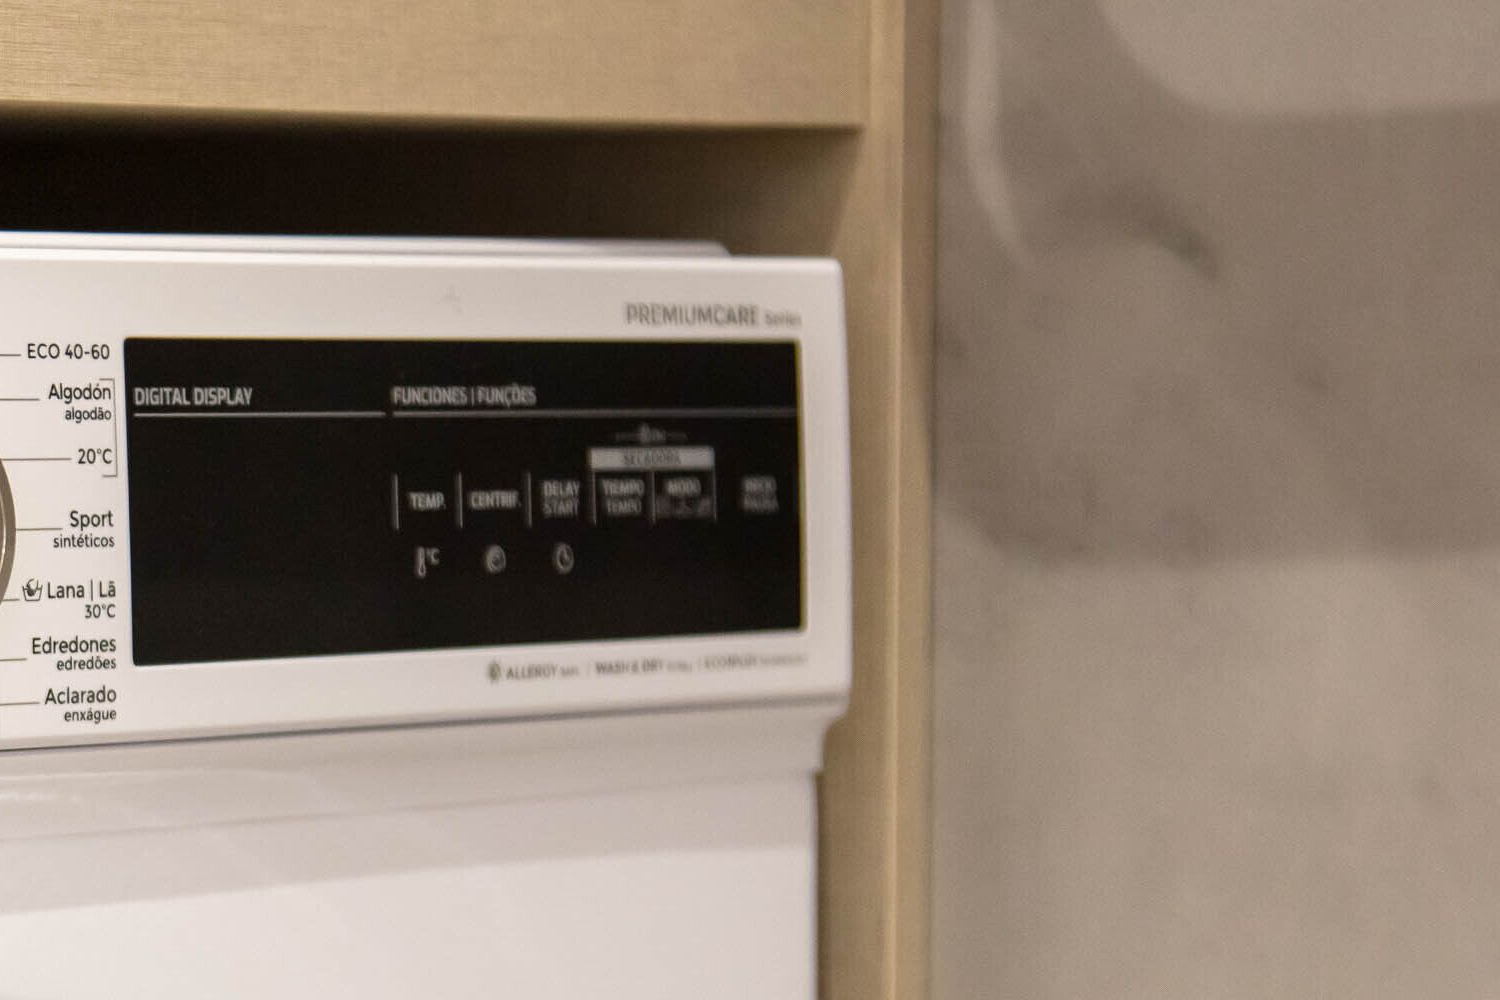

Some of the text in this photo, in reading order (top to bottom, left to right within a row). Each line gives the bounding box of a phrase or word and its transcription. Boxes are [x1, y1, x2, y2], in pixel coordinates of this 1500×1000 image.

[27, 343, 110, 360] ECO 40-60
[48, 382, 112, 405] Algodón
[134, 386, 253, 406] DIGITAL DISPLAY
[392, 385, 467, 406] FUNCIONES
[64, 406, 112, 423] algodão
[77, 448, 113, 464] 20°C
[69, 510, 114, 531] Sport
[53, 533, 115, 548] sintéticos
[47, 580, 116, 599] Lana Lã
[85, 604, 116, 619] 30°C
[32, 636, 116, 654] Edredones
[56, 656, 116, 671] edredões
[44, 685, 117, 705] Aclarado
[64, 708, 117, 724] enxágue
